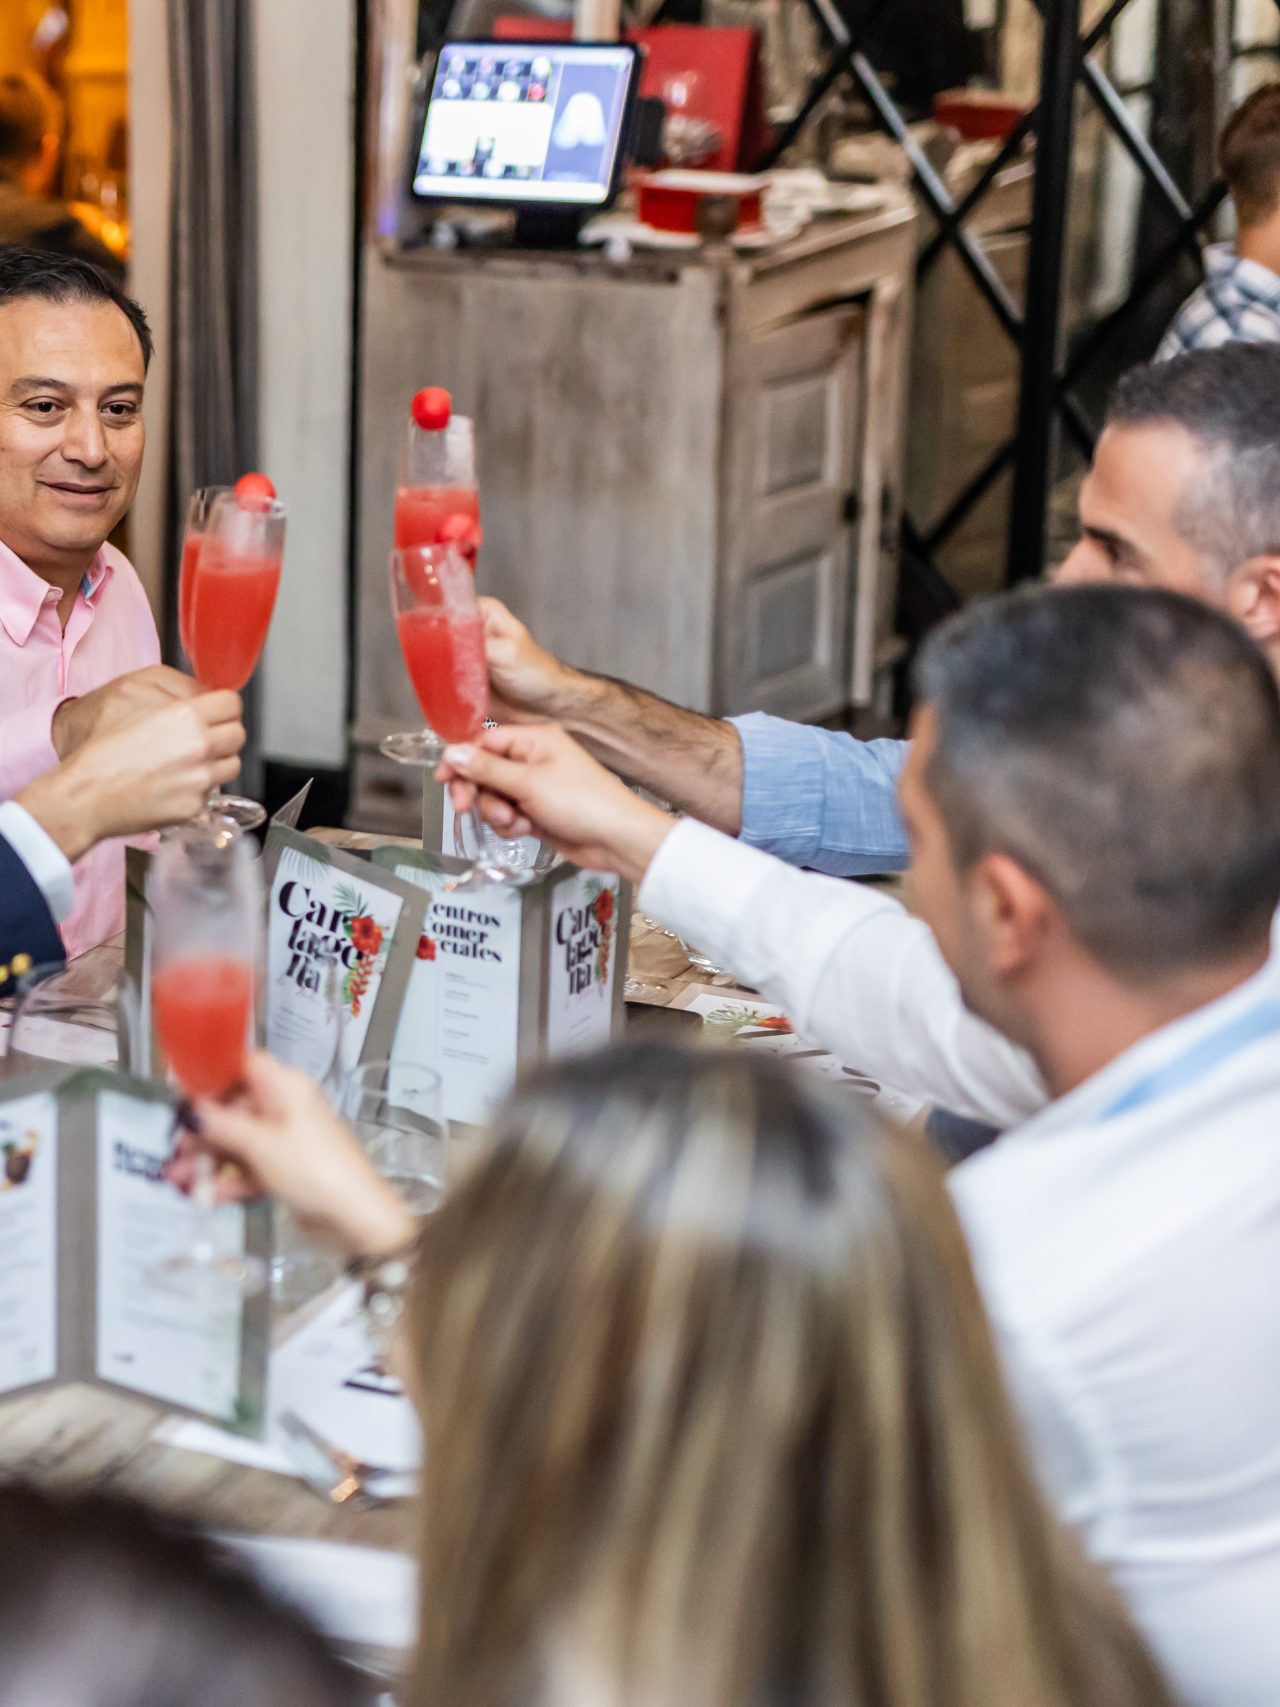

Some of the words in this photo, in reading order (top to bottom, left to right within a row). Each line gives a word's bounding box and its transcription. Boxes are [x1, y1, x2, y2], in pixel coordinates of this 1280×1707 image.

[279, 881, 350, 933] Car
[432, 903, 501, 928] entros
[429, 921, 489, 944] omer
